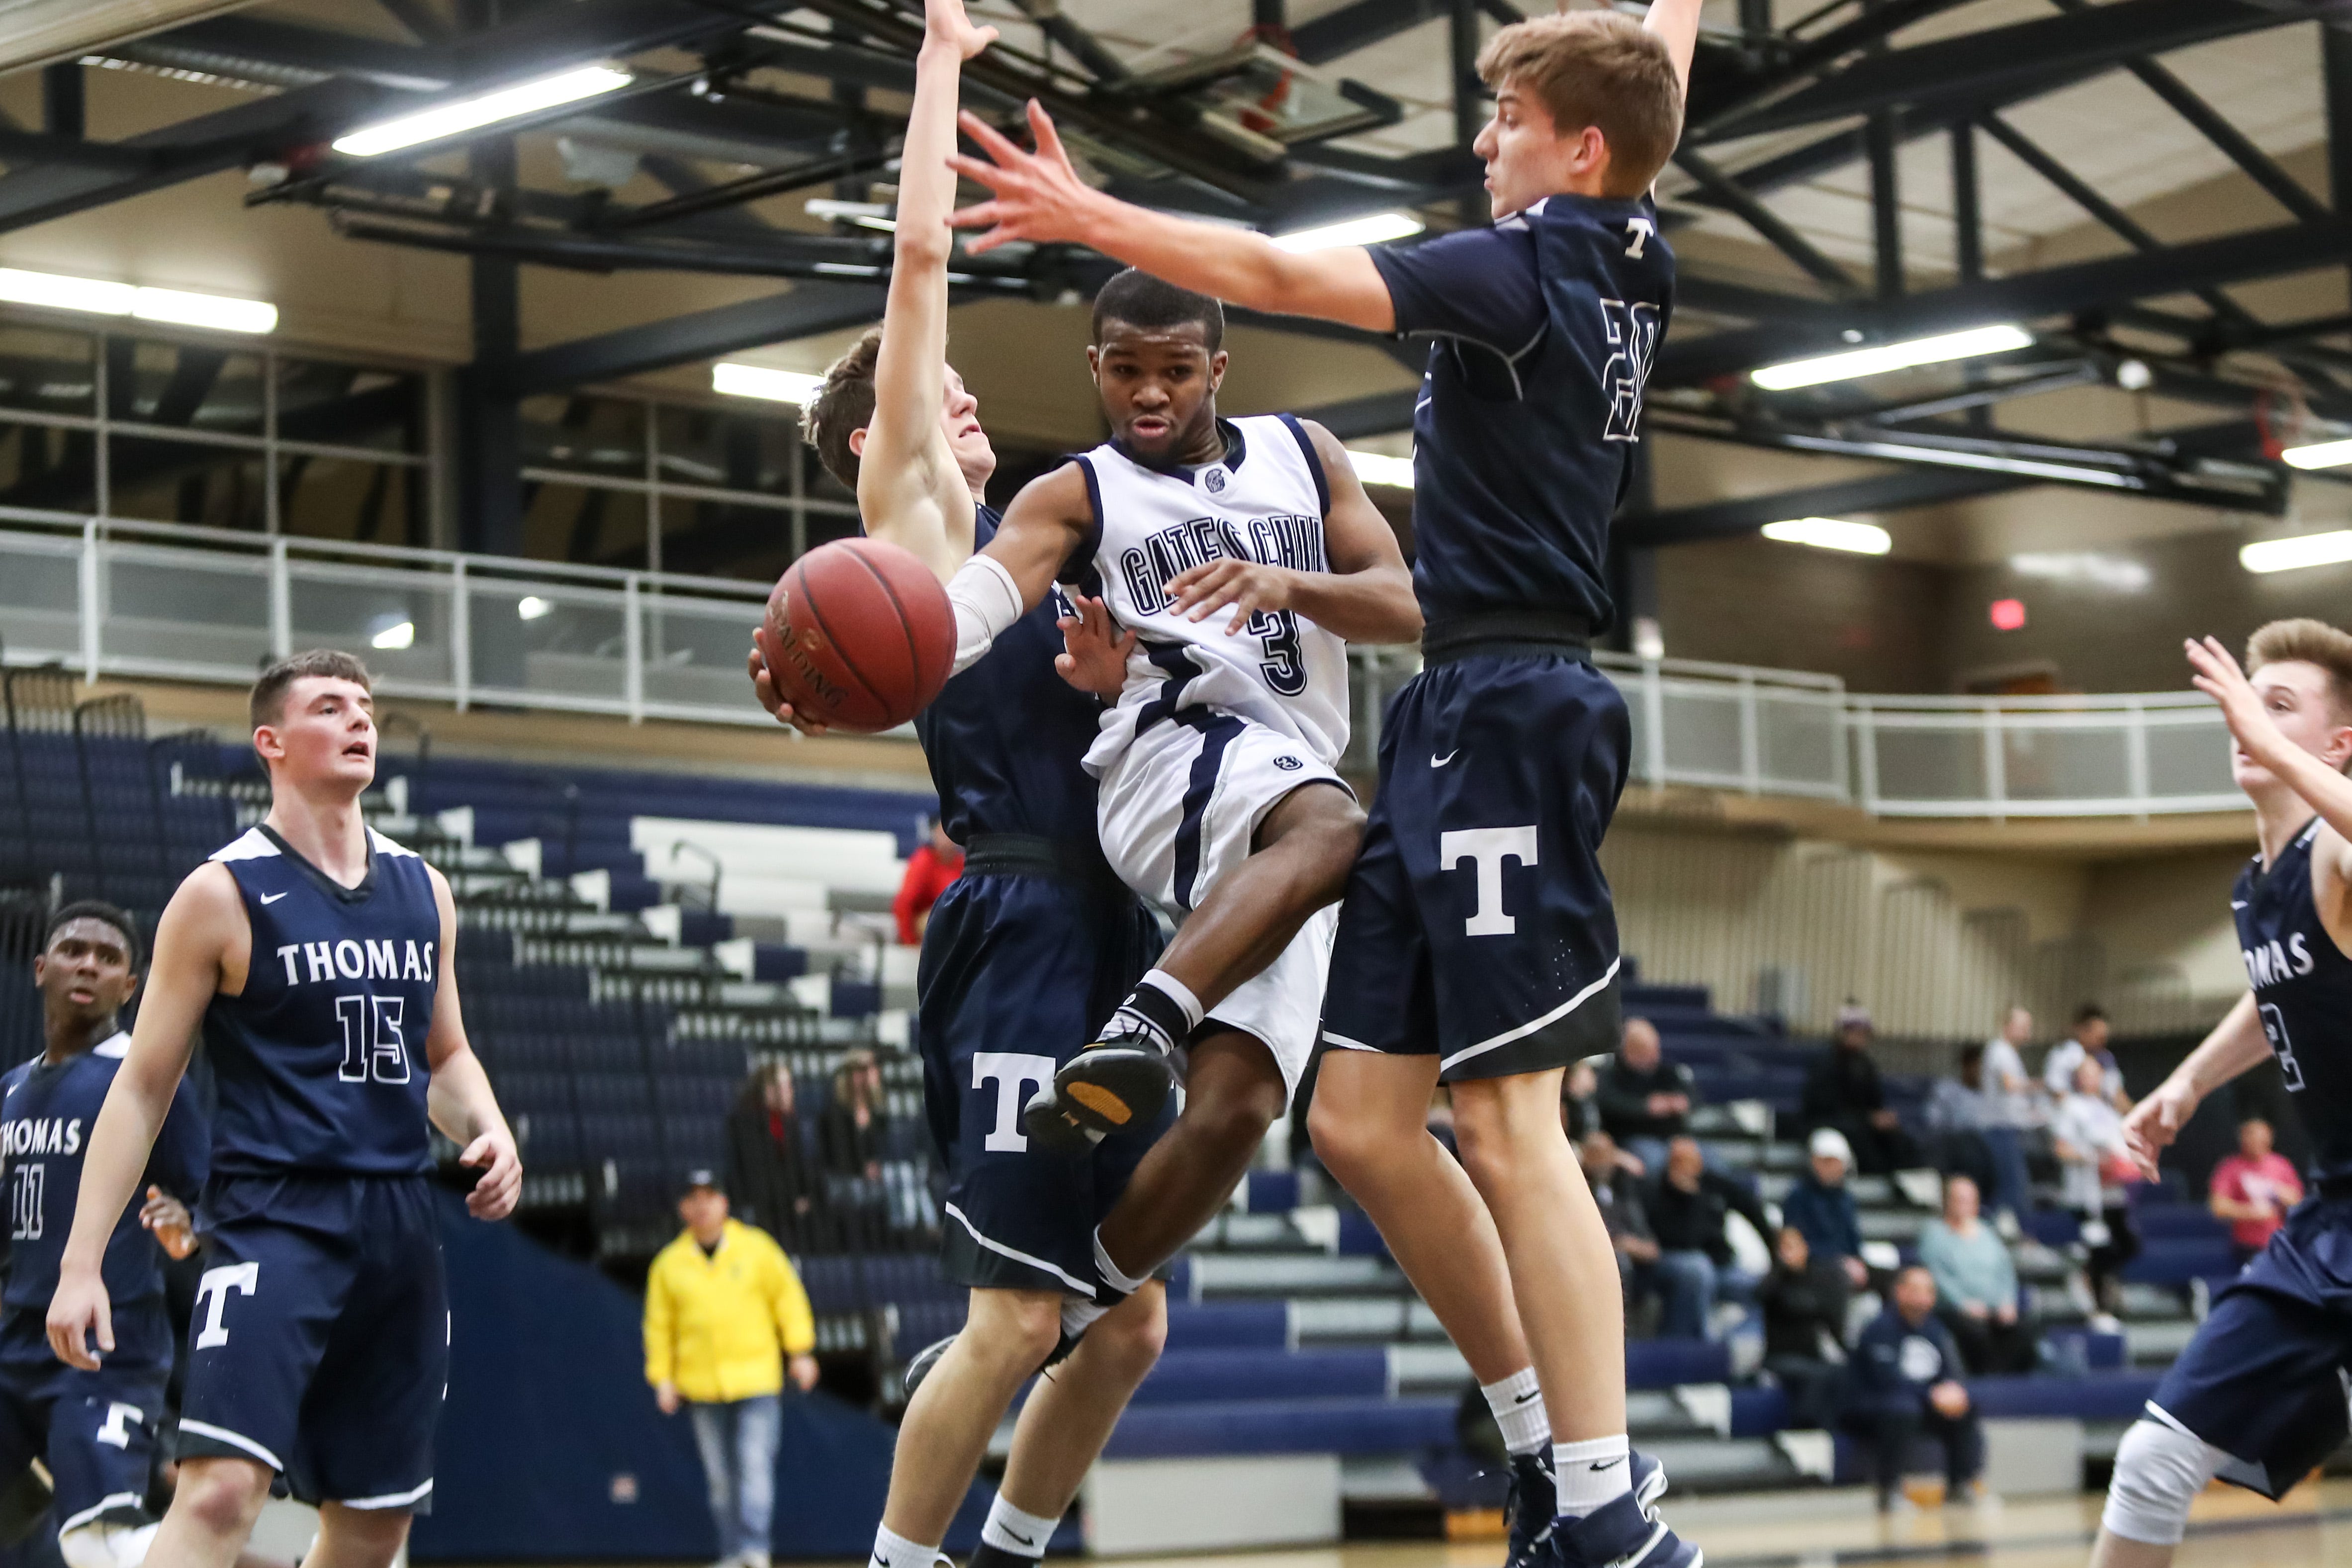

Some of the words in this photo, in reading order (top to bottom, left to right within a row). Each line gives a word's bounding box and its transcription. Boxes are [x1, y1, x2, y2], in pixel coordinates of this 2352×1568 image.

[1625, 217, 1654, 259] T
[1248, 609, 1307, 696] 3
[1441, 825, 1538, 936] T
[277, 939, 434, 987] THOMAS
[2243, 931, 2314, 991] OMAS
[335, 995, 411, 1085] 15
[0, 1117, 81, 1156] HOMAS
[972, 1052, 1056, 1153] T
[195, 1261, 259, 1351] T
[97, 1401, 143, 1451] T
